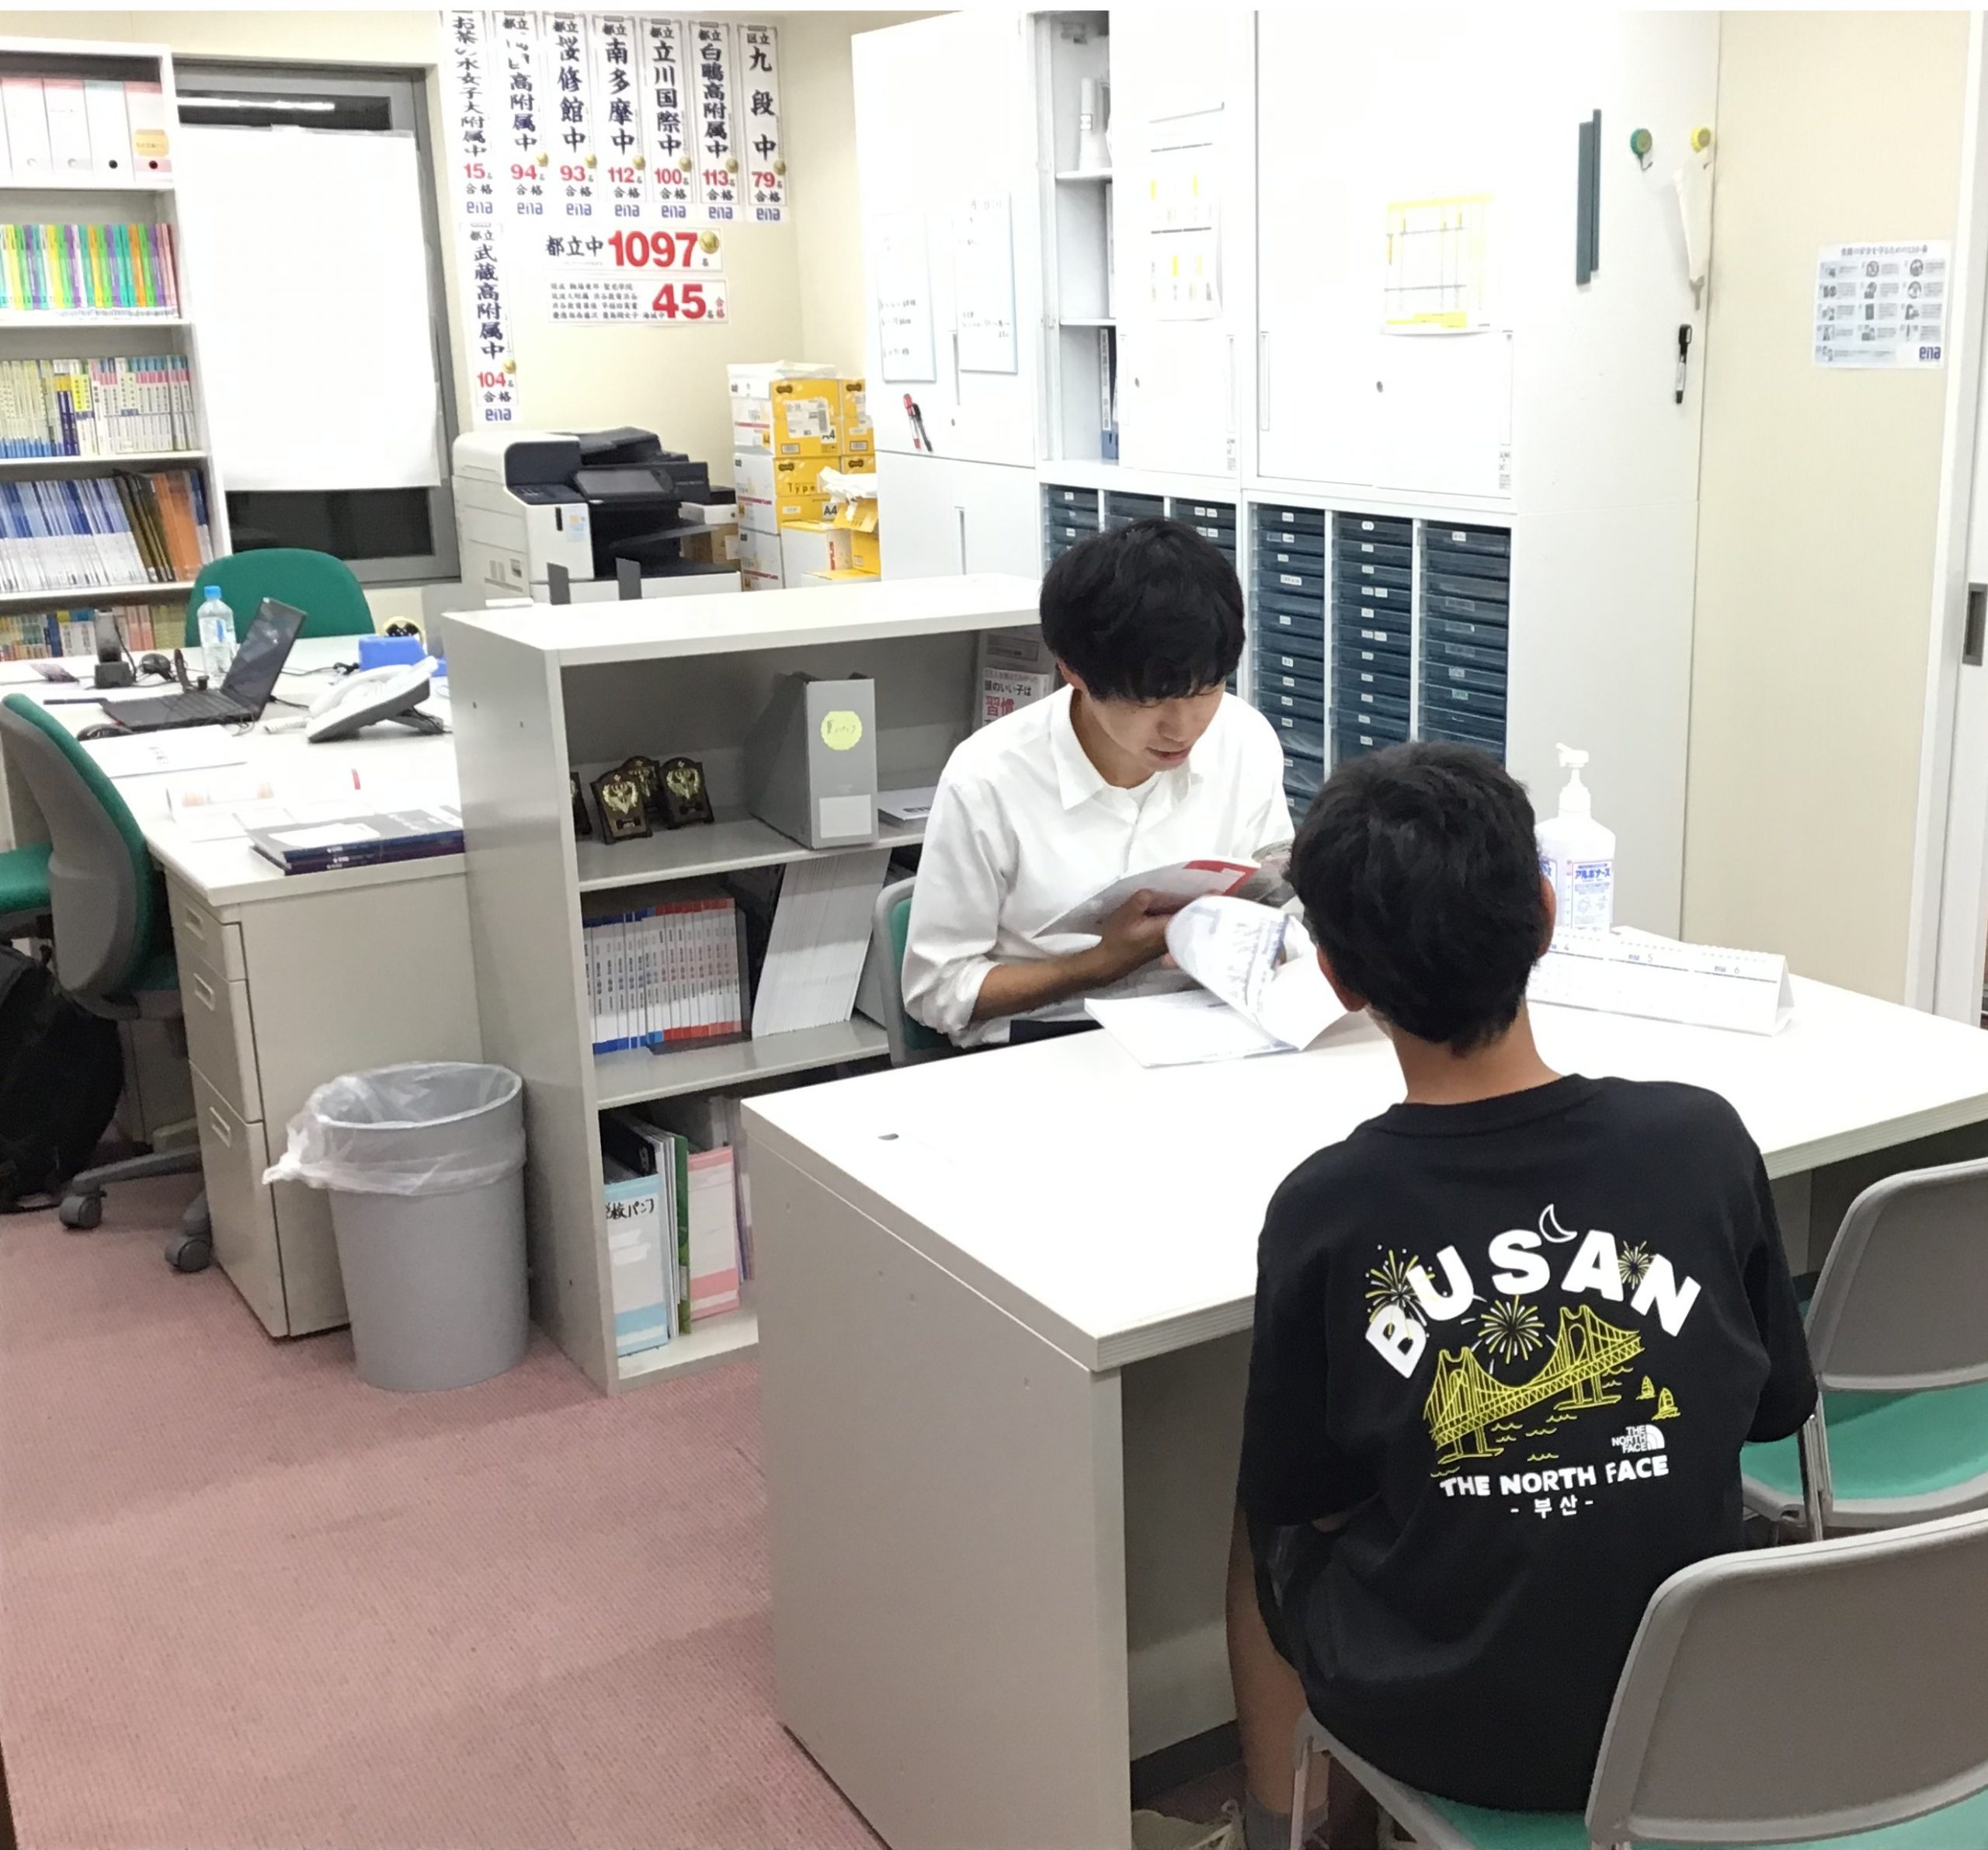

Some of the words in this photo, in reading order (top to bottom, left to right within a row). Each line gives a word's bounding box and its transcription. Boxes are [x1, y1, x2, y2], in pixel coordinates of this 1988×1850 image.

[506, 32, 537, 151] 高附属中
[555, 35, 586, 153] 桜修館中
[606, 37, 634, 155] 南多摩中
[652, 40, 682, 157] 立川国際中
[749, 46, 777, 161] 九段中
[466, 183, 492, 194] 合格
[516, 184, 543, 196] 合格
[565, 185, 593, 196] 合格
[613, 186, 640, 198] 合格
[659, 187, 686, 200] 合格
[707, 189, 734, 201] 合格
[755, 190, 780, 203] 合格
[545, 235, 603, 257] 都立中
[474, 243, 505, 360] 武蔵高附属中
[1919, 346, 1941, 360] ena
[483, 391, 512, 403] 合格
[485, 408, 512, 421] ena
[787, 482, 815, 494] Type
[823, 506, 837, 516] A4
[985, 695, 1015, 716] 習慣
[1365, 1229, 1701, 1379] BUSAN
[1625, 1424, 1646, 1435] THE
[1611, 1434, 1646, 1447] NORTH
[1621, 1442, 1647, 1454] FACE
[1440, 1475, 1490, 1497] THE
[1500, 1466, 1597, 1495] NORTH
[1605, 1455, 1669, 1483] FACE
